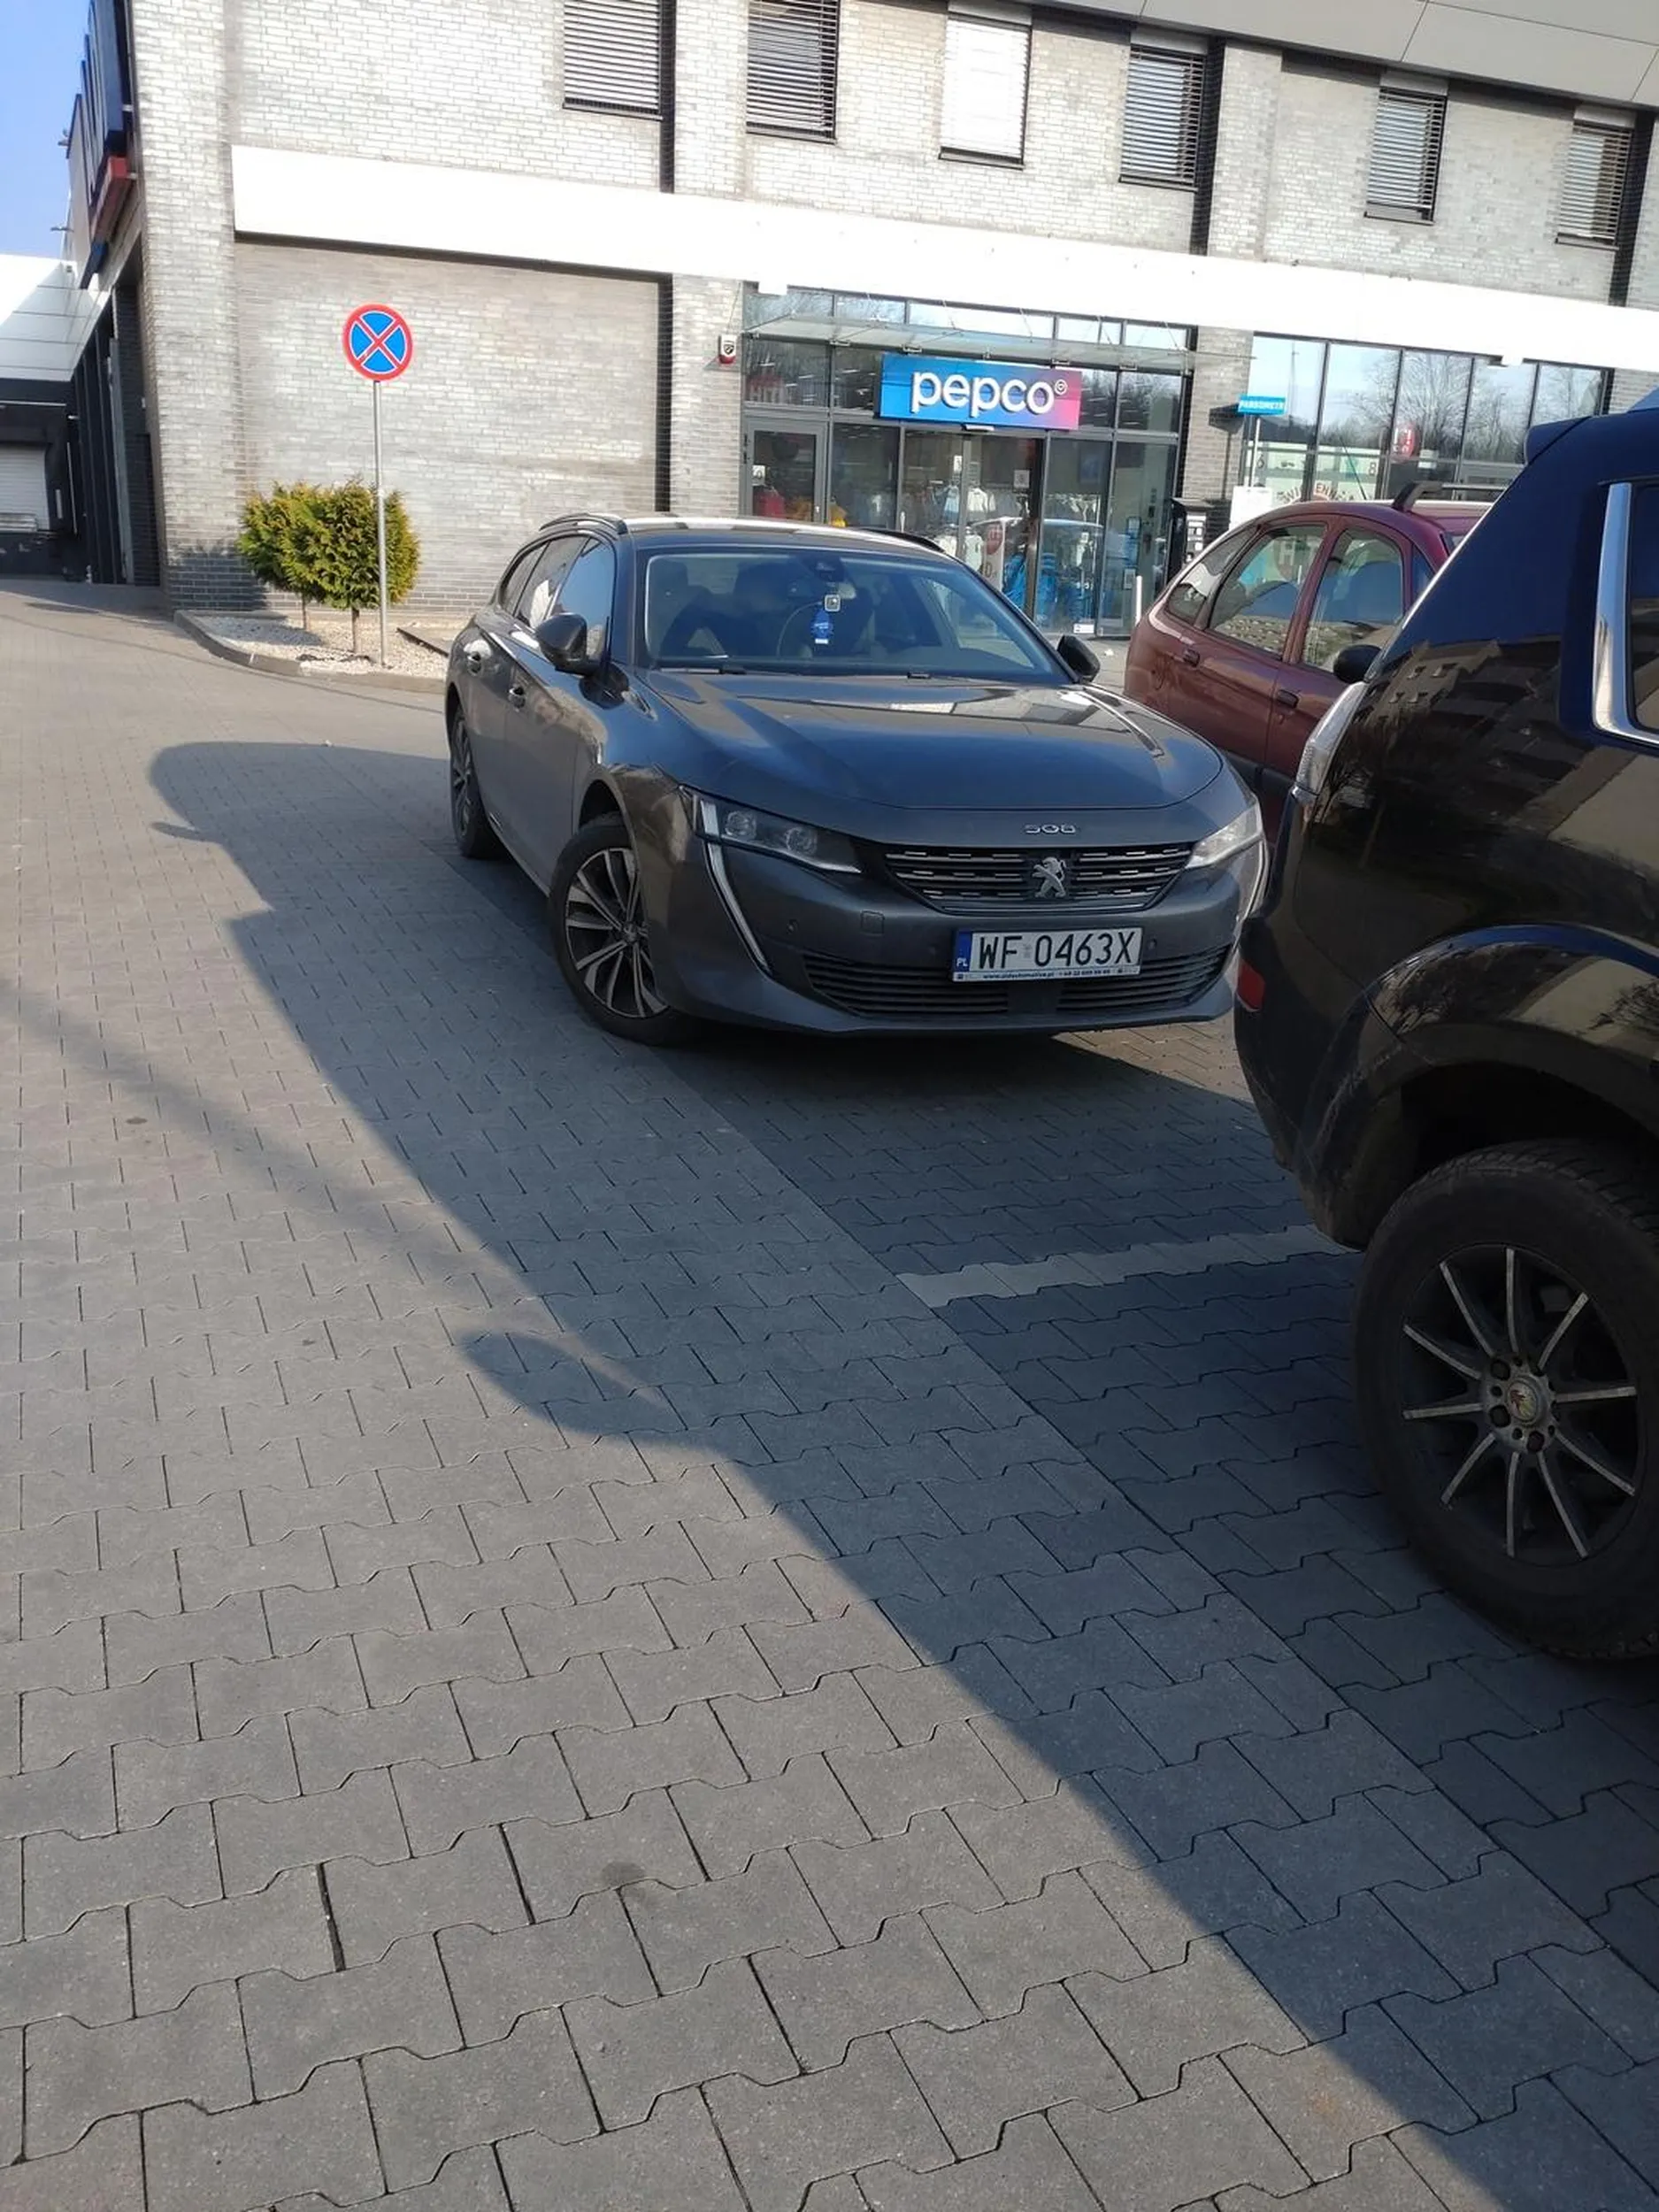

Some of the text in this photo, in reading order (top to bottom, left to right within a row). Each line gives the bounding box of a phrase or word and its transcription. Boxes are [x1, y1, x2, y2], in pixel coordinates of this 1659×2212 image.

[911, 370, 1055, 419] pepco
[979, 932, 1135, 969] WF 0463X
